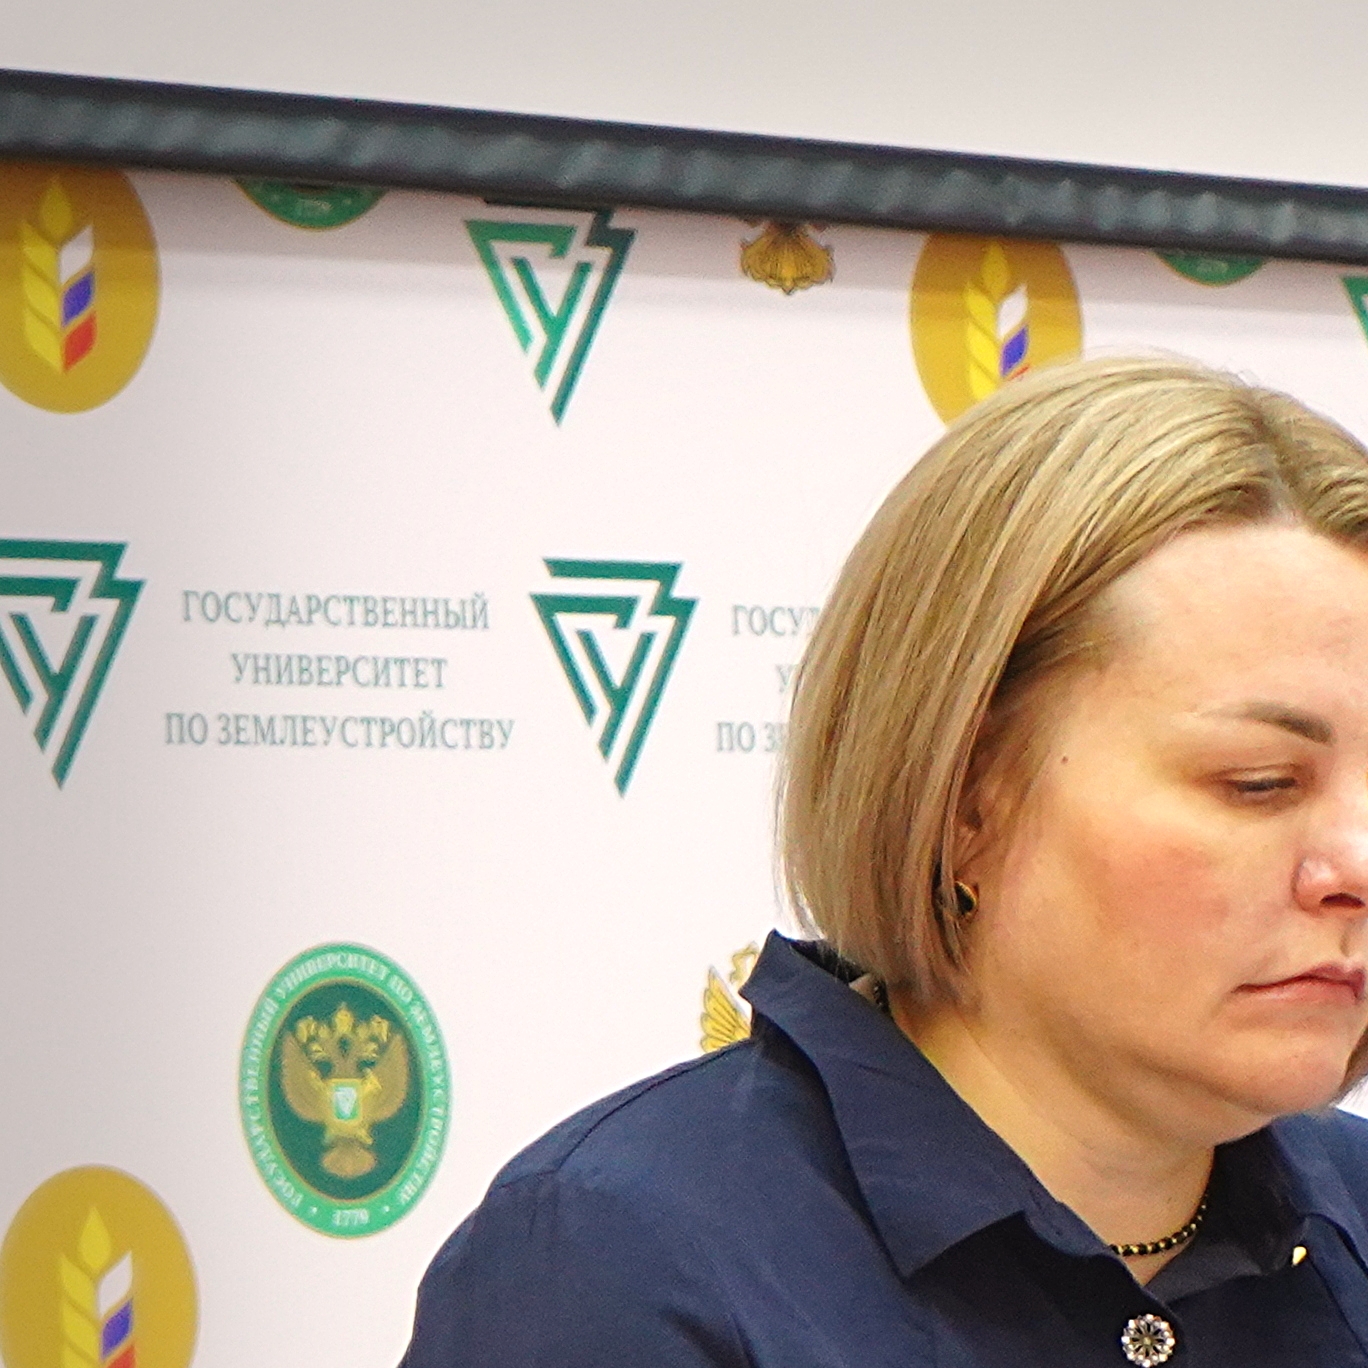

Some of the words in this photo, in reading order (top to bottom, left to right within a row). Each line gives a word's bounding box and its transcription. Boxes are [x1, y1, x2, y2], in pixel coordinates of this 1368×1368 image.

[182, 590, 490, 629] ГОСУДАРСТВЕННЫЙ
[231, 652, 448, 689] УНИВЕРСИТЕТ
[165, 712, 208, 745] ПО
[218, 710, 515, 750] ЗЕМЛЕУСТРОЙСТВУ
[717, 721, 755, 752] ПО
